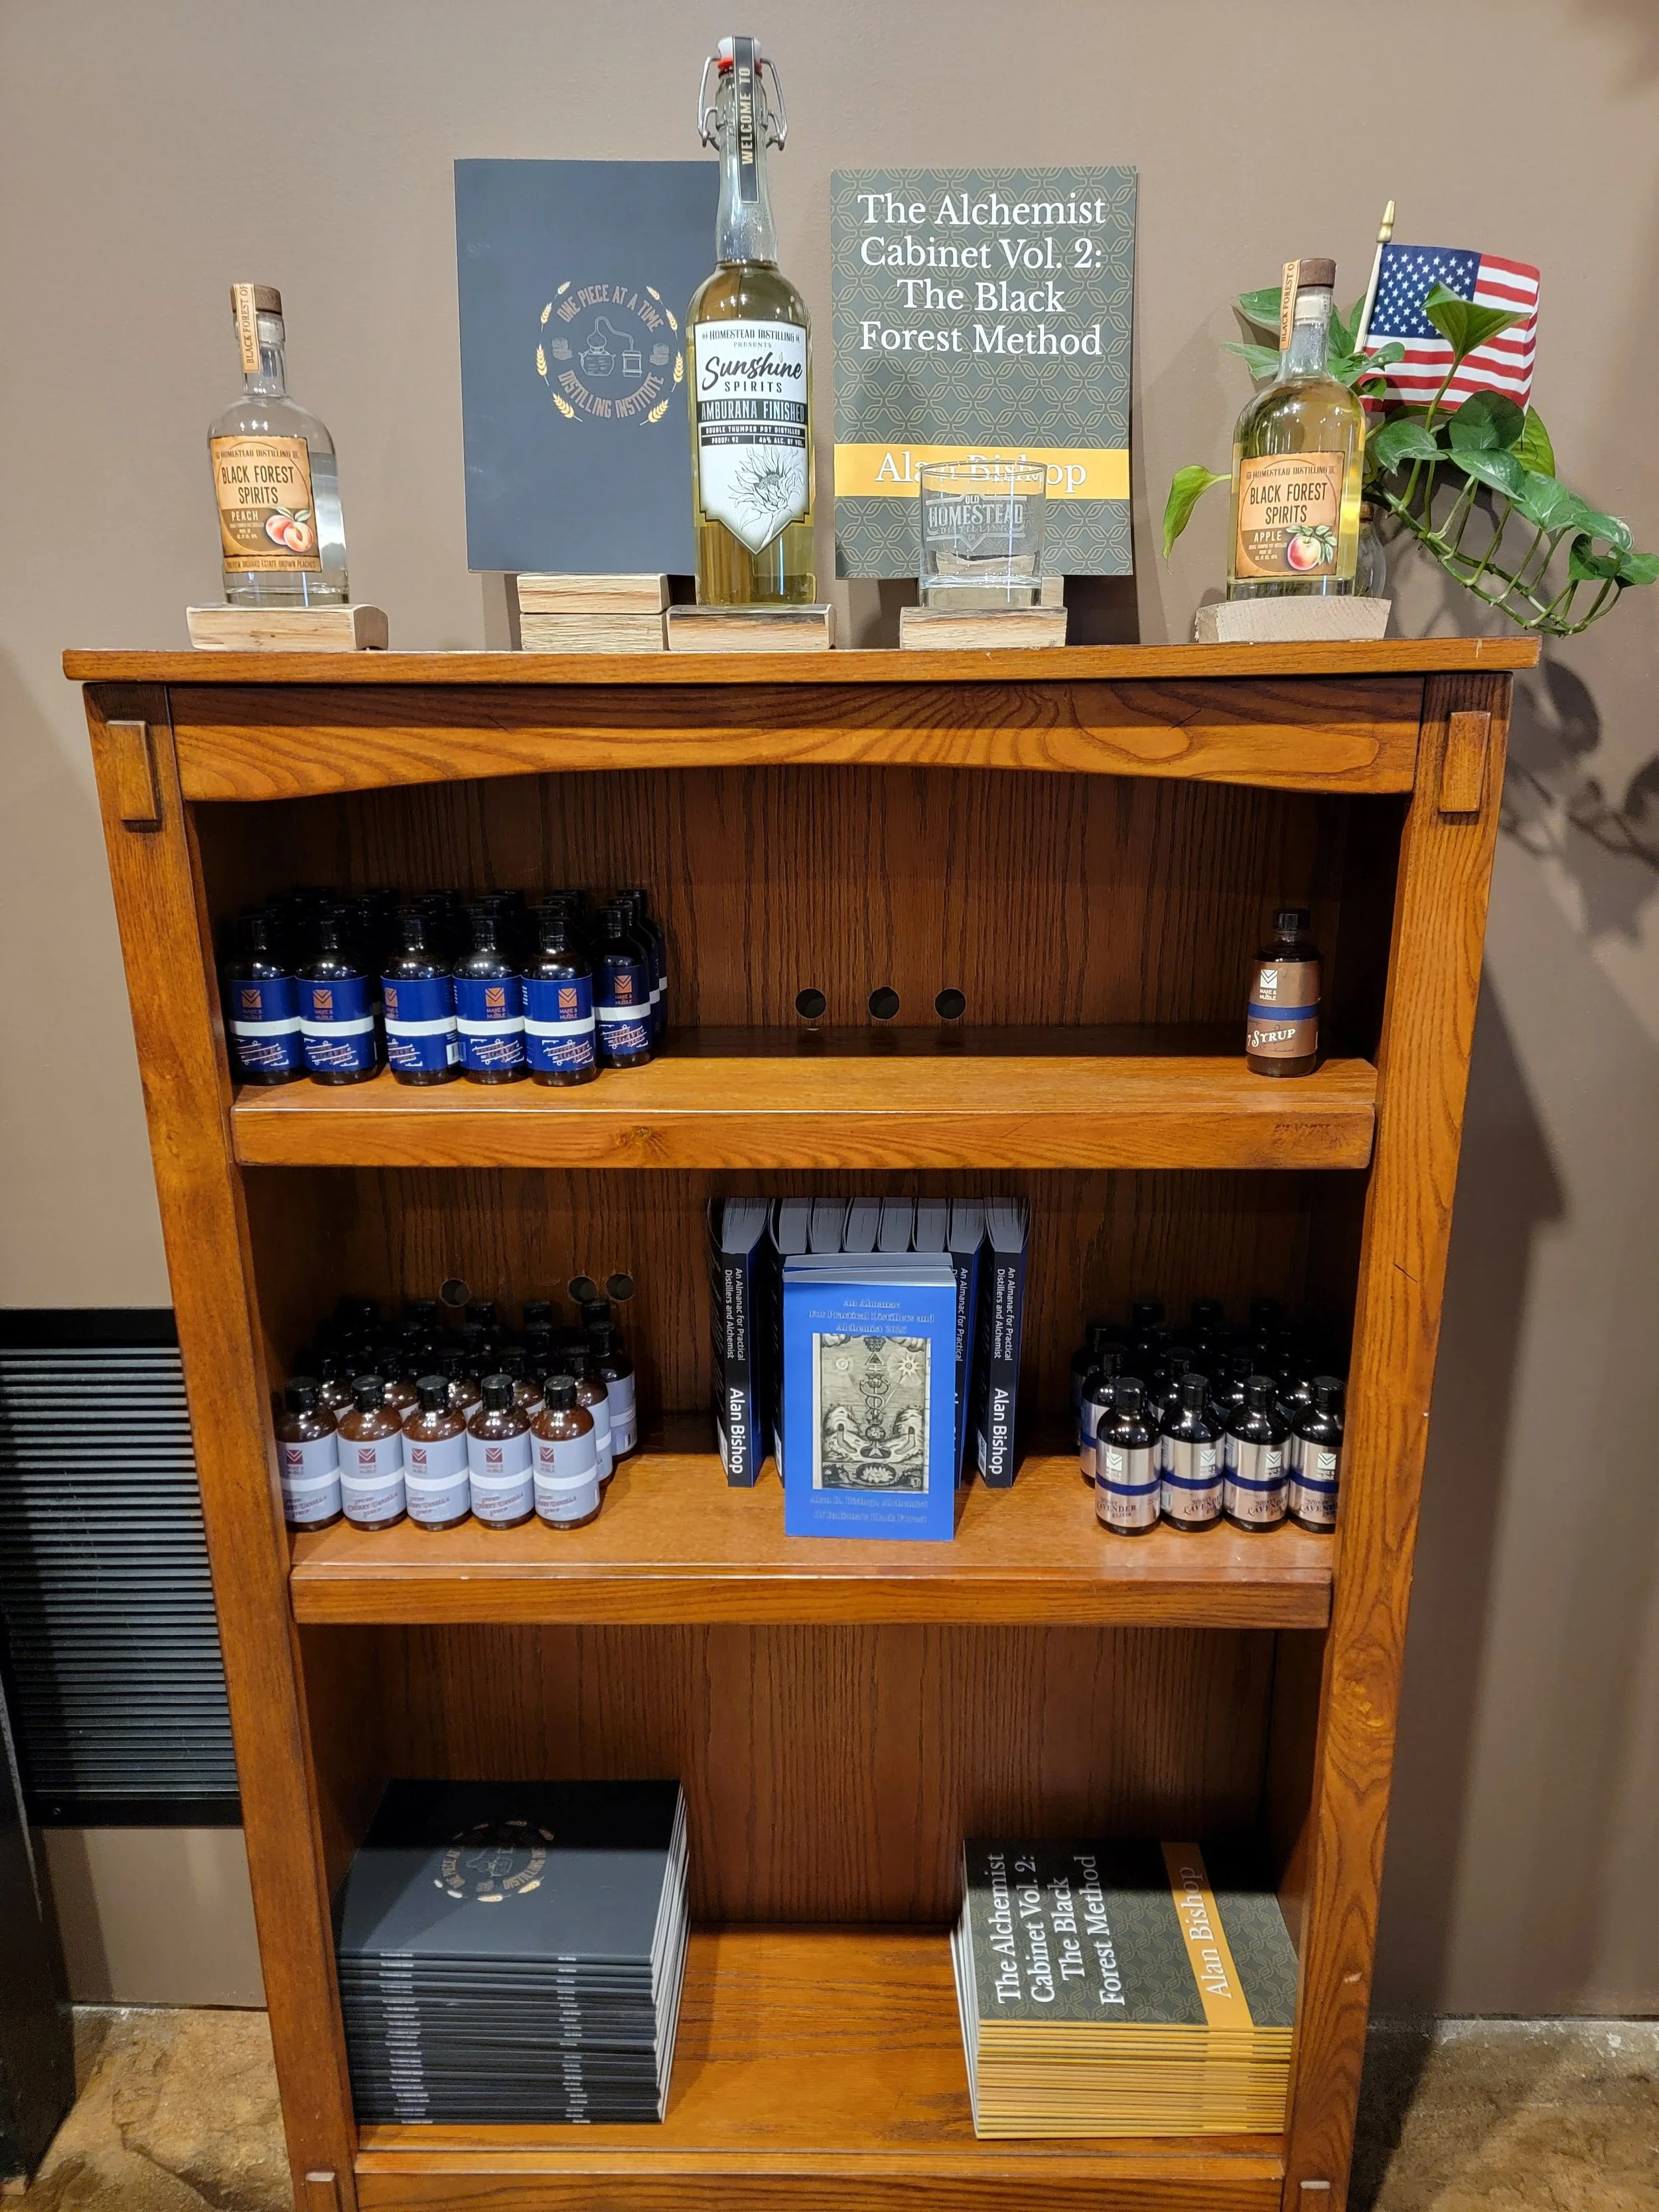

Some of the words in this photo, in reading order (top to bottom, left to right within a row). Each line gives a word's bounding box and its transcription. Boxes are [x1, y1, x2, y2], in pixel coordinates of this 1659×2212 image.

[739, 68, 751, 85] TO
[739, 92, 754, 165] WELCOME
[857, 192, 926, 224] The
[934, 192, 1106, 226] Alchemist
[861, 236, 991, 269] Cabinet
[999, 237, 1062, 269] Vol.
[1073, 238, 1102, 269] 2:
[556, 295, 581, 323] ONE
[577, 284, 610, 307] PIECE
[612, 285, 628, 305] AT
[626, 293, 639, 311] A
[637, 299, 664, 332] TIME
[897, 278, 964, 311] The
[975, 281, 1066, 313] Black
[1283, 273, 1293, 310] FOREST
[240, 299, 251, 333] FOREST
[244, 334, 255, 364] BLACK
[709, 329, 755, 340] HOMESTEAD
[758, 329, 794, 342] DISTILLING
[860, 321, 962, 352] Forest
[972, 324, 1102, 356] Method
[701, 352, 803, 391] Sunshine
[725, 381, 782, 394] SPIRITS
[557, 369, 612, 419] DISTILLING
[614, 372, 665, 419] INSTITUTE
[701, 400, 758, 421] AMBURANA
[763, 400, 804, 423] FINISHED
[774, 427, 800, 435] DISTILLED
[221, 449, 253, 459] HOMESTEAD
[256, 449, 291, 458] DISTILLING
[222, 466, 250, 484] BLACK
[255, 466, 294, 483] FOREST
[875, 451, 956, 484] Alan
[967, 453, 1086, 493] Bishop
[1253, 467, 1291, 479] HOMESTEAD
[1293, 466, 1327, 475] DISTILLING
[238, 486, 279, 504] SPIRITS
[965, 494, 979, 505] OLD
[1250, 484, 1281, 505] BLACK
[1287, 482, 1328, 502] FOREST
[231, 510, 259, 522] PEACH
[928, 504, 1024, 528] HOMESTEAD
[941, 525, 1007, 535] DITILLING
[1265, 504, 1307, 524] SPIRITS
[1254, 531, 1282, 543] APPLE
[1252, 1028, 1295, 1047] SYRUP
[725, 1270, 733, 1304] Distillers
[735, 1268, 743, 1279] An
[960, 1268, 968, 1279] An
[996, 1269, 1005, 1303] Distillers
[1007, 1267, 1016, 1279] An
[726, 1305, 735, 1319] and
[735, 1280, 744, 1314] Almanac
[958, 1280, 968, 1314] Almanac
[995, 1305, 1004, 1319] and
[1006, 1280, 1016, 1314] Almanac
[736, 1315, 745, 1327] for
[958, 1315, 966, 1327] for
[1006, 1315, 1015, 1327] for
[737, 1328, 746, 1361] Practical
[956, 1329, 965, 1361] Practical
[994, 1320, 1004, 1359] Alchemist
[1005, 1328, 1014, 1361] Practical
[730, 1388, 745, 1421] Alan
[993, 1388, 1009, 1422] Alan
[729, 1425, 747, 1474] Bishop
[988, 1425, 1008, 1475] Bishop
[1014, 1853, 1037, 1873] 2:
[984, 1852, 1015, 1957] Alchemist
[1016, 1879, 1042, 1919] Vol.
[1047, 1877, 1077, 1935] Black
[1074, 1855, 1110, 1936] Method
[1180, 1867, 1215, 1942] Bishop
[1025, 1922, 1055, 2003] Cabinet
[1058, 1939, 1086, 1981] The
[1094, 1940, 1125, 2006] Forest
[1200, 1948, 1232, 2000] Alan
[995, 1959, 1021, 2004] The
